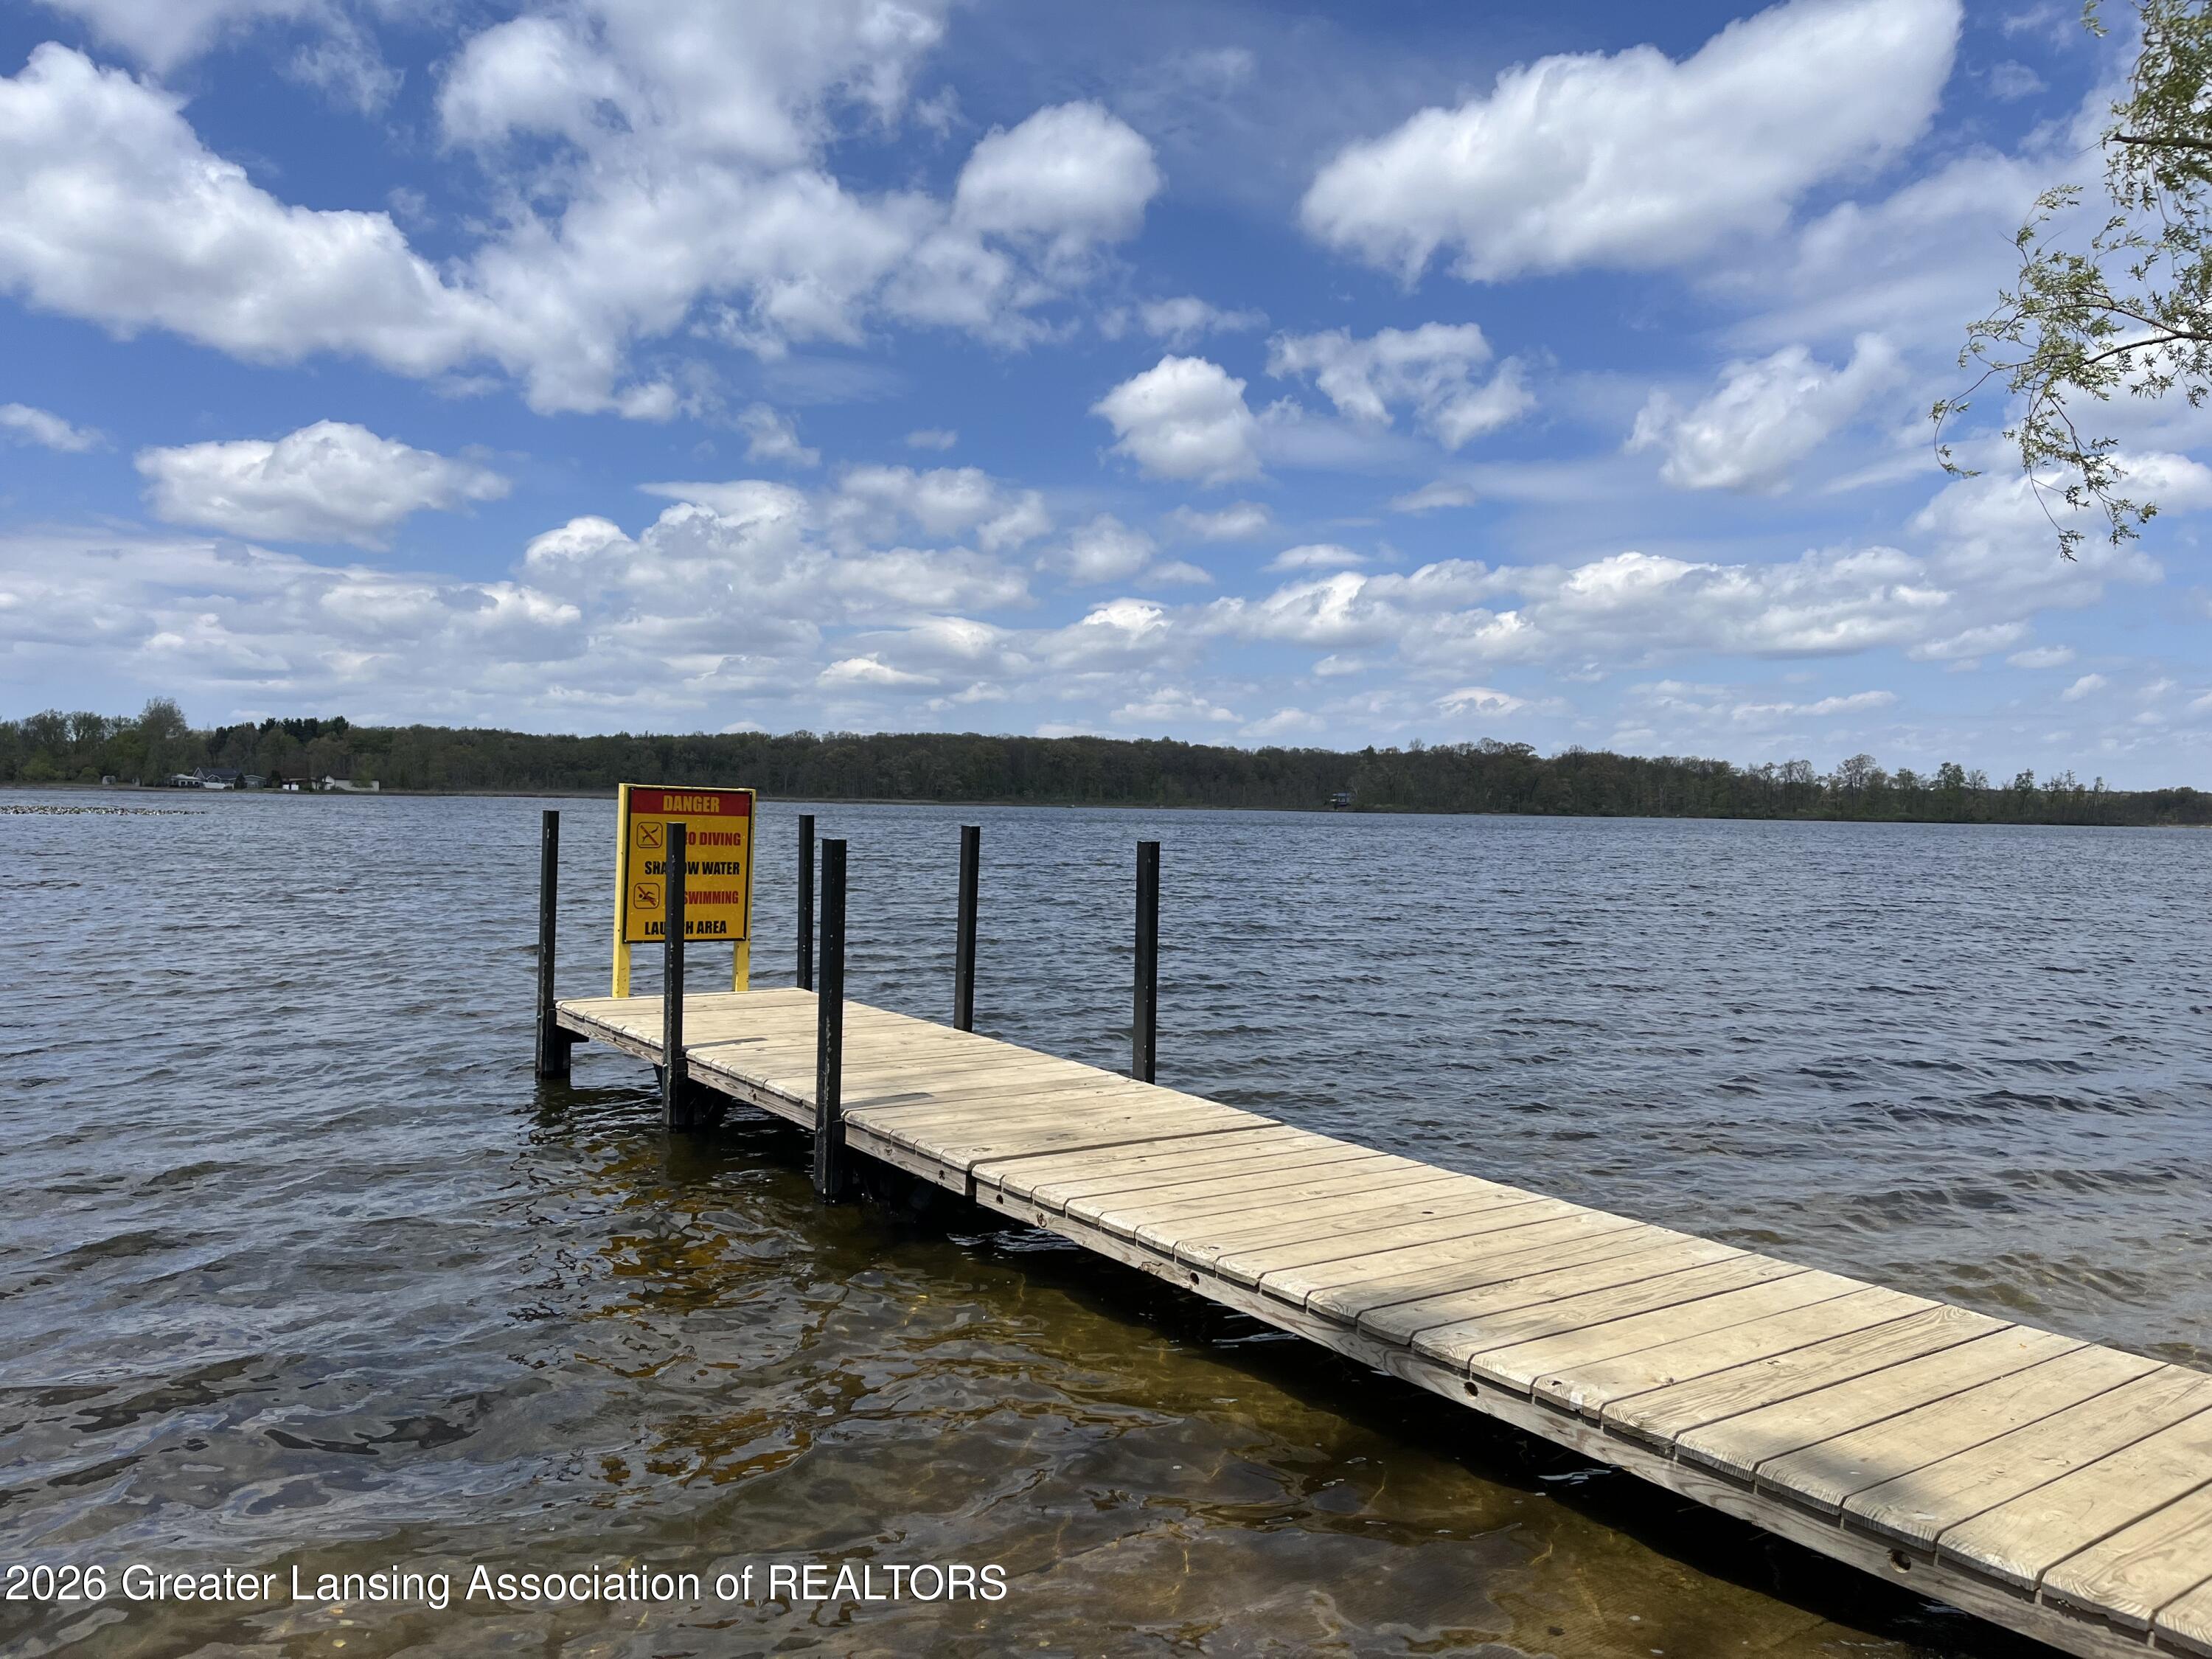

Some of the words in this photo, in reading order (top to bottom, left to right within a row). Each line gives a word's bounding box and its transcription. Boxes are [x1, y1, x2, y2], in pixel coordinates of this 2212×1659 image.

[663, 796, 720, 813] DANGER
[699, 832, 741, 846] DIVING
[644, 861, 700, 874] SHAW
[702, 861, 740, 875] WATER
[644, 921, 693, 935] LAUH
[696, 920, 727, 934] AREA
